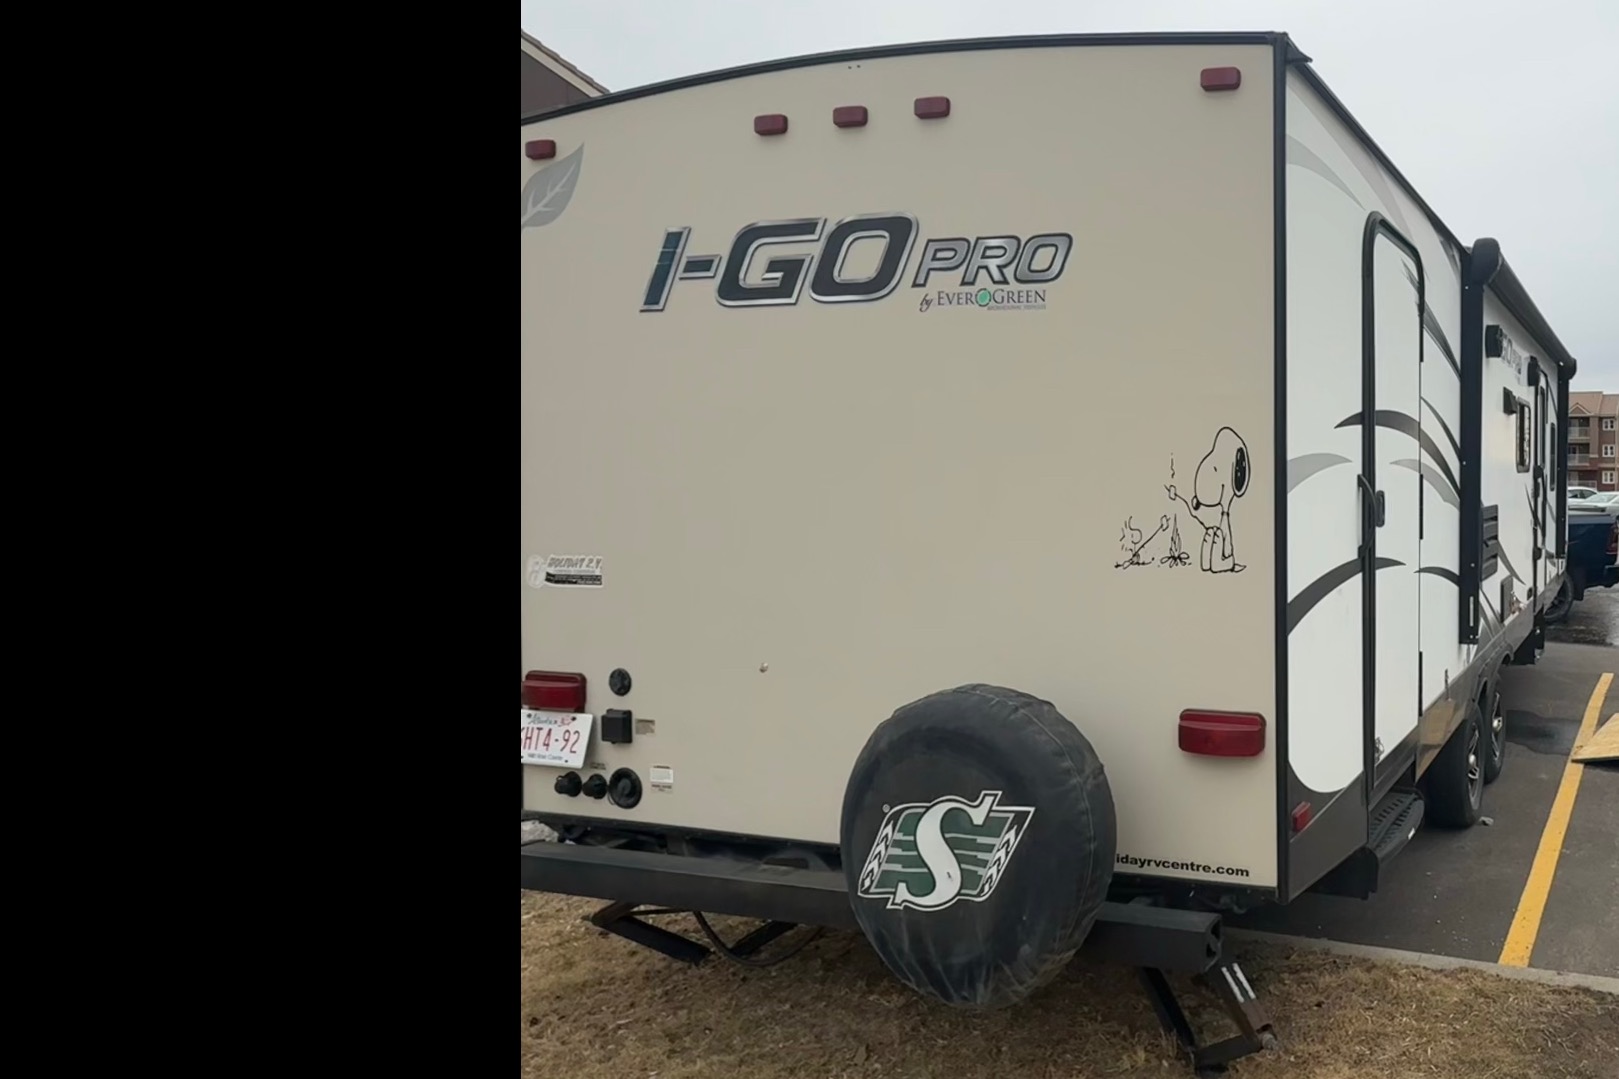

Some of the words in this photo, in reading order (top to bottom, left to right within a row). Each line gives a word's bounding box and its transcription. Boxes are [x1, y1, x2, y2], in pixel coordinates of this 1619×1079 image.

[640, 211, 919, 312] I-GO
[912, 233, 1074, 288] PRO
[919, 293, 933, 312] by
[1115, 853, 1250, 877] idayrvcentre.com
